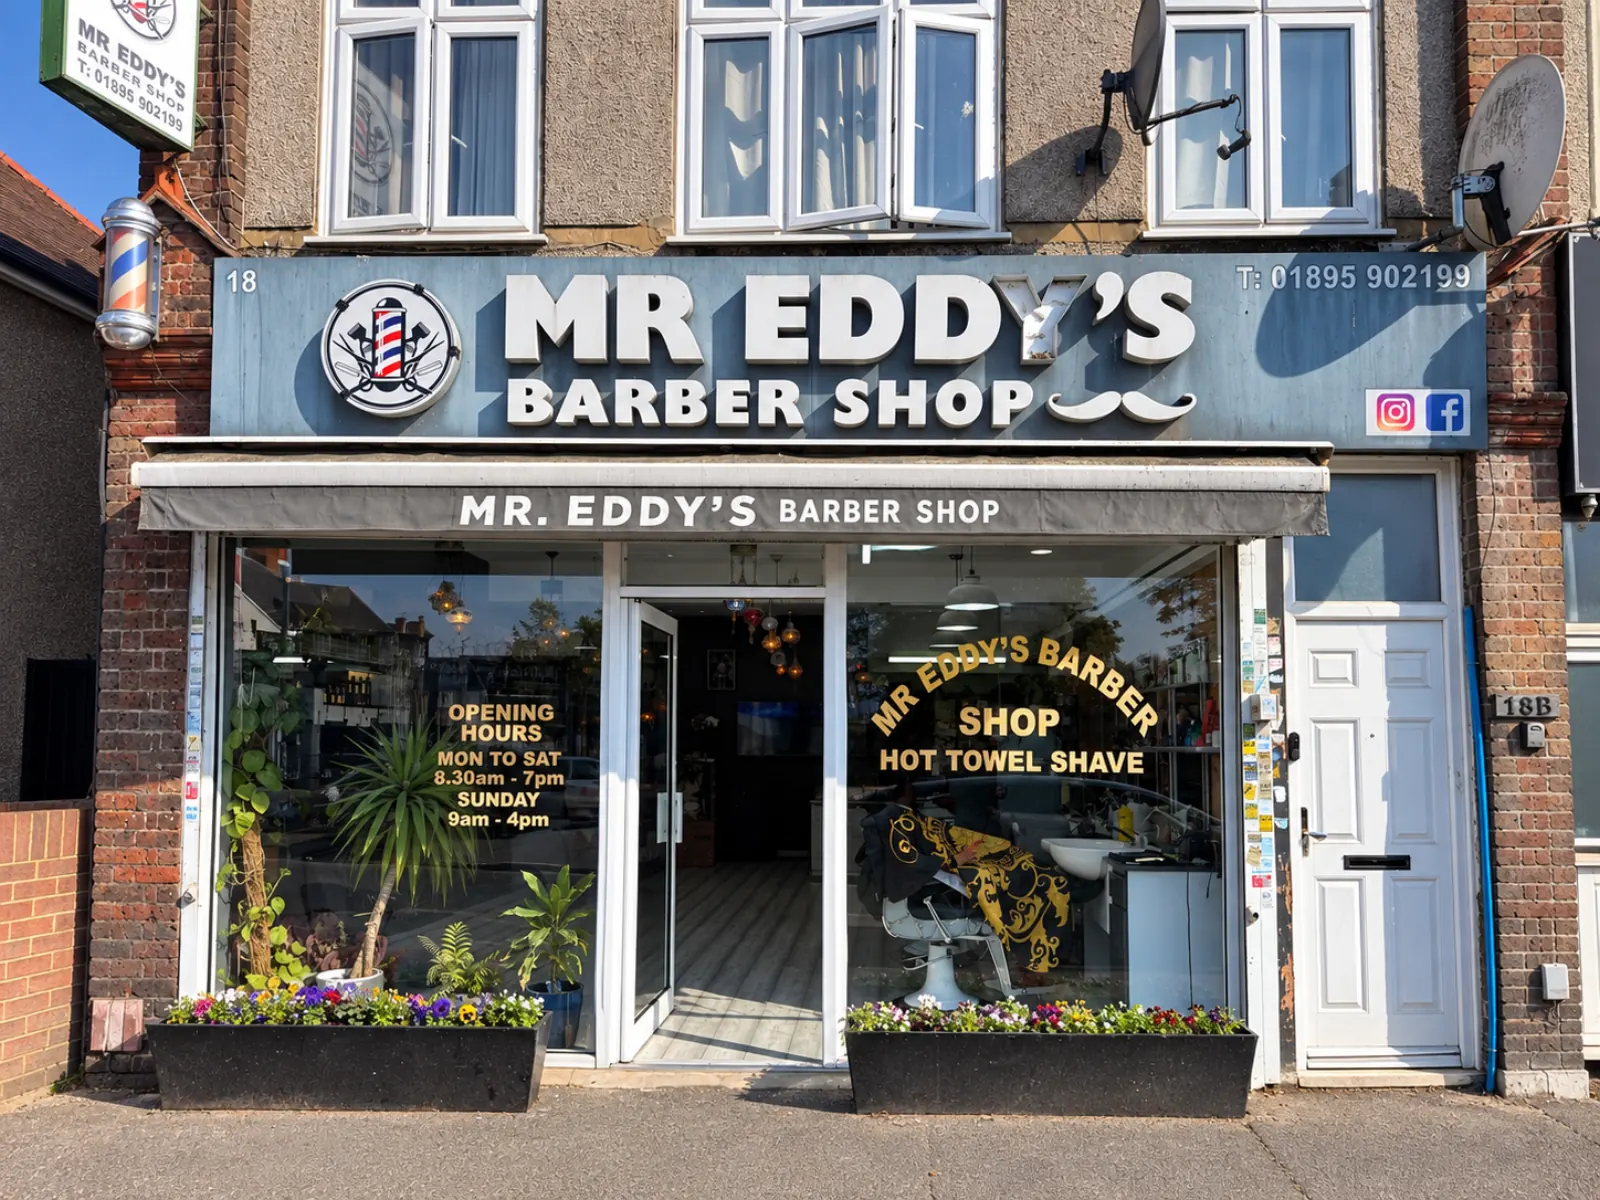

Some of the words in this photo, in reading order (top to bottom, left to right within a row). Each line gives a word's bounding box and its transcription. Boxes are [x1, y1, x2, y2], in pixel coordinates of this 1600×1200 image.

[78, 18, 110, 53] MR
[118, 42, 186, 99] EDDY'S
[78, 40, 141, 88] BARBER
[146, 83, 185, 113] SHOP
[78, 58, 91, 77] T:
[95, 71, 134, 103] 01895
[139, 96, 183, 132] 902199
[226, 269, 257, 293] 18
[1236, 266, 1261, 290] T:
[1271, 264, 1356, 290] 01895
[1367, 264, 1471, 289] 902199
[505, 274, 704, 364] MR
[745, 271, 1196, 365] EDDY'S
[507, 378, 804, 428] BARBER
[833, 378, 1034, 429] SHOP
[460, 496, 547, 527] MR.
[567, 495, 756, 527] EDDY'S
[779, 499, 900, 524] BARBER
[916, 499, 999, 524] SHOP
[871, 684, 920, 736] MR
[916, 635, 1029, 693] EDDY'S
[1038, 637, 1159, 738] BARBER
[448, 703, 555, 721] OPENING
[1503, 696, 1552, 716] 18B
[461, 724, 543, 742] HOURS
[959, 706, 1060, 737] SHOP
[437, 751, 483, 766] MON
[489, 751, 517, 766] TO
[523, 751, 562, 766] SAT
[880, 749, 937, 770] HOT
[945, 749, 1041, 772] TOWEL
[1050, 751, 1144, 773] SHAVE
[434, 770, 505, 786] 8.30am
[523, 770, 564, 789] 7pm
[457, 791, 541, 808] SUNDAY
[448, 811, 489, 827] 9am
[506, 811, 549, 830] 4pm
